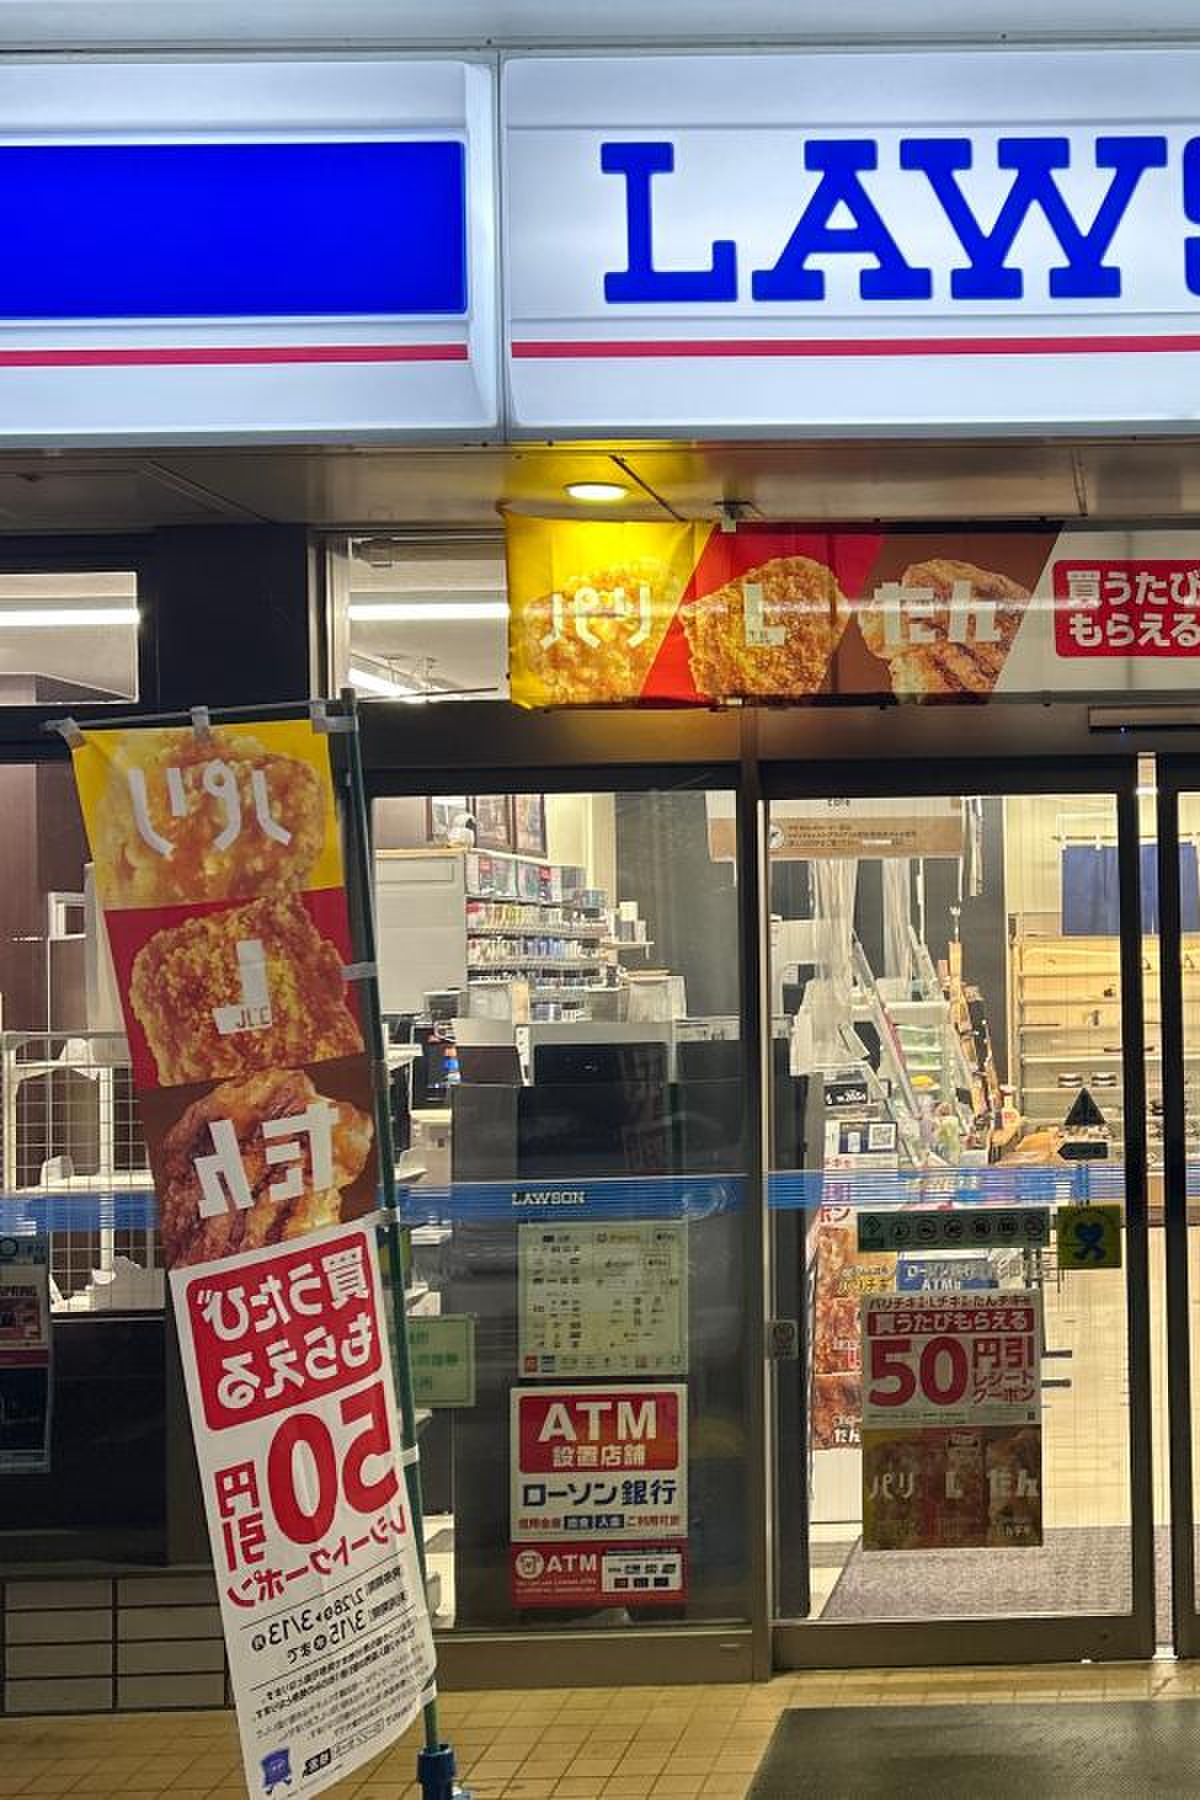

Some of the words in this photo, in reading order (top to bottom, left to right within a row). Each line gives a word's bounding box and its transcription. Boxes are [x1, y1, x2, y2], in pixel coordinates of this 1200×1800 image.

[540, 582, 652, 649] パリ
[874, 581, 1001, 645] たん
[511, 1191, 585, 1206] LAWSON
[876, 1312, 1028, 1335] 買うたびもらえる
[972, 1336, 1035, 1369] 円引
[868, 1336, 968, 1407] 50
[972, 1371, 1035, 1386] レシート
[973, 1387, 1035, 1406] クーポン
[537, 1400, 658, 1443] ATM
[552, 1444, 647, 1468] 設置店舗
[522, 1480, 677, 1507] ローソン銀行
[545, 1553, 598, 1573] ATM
